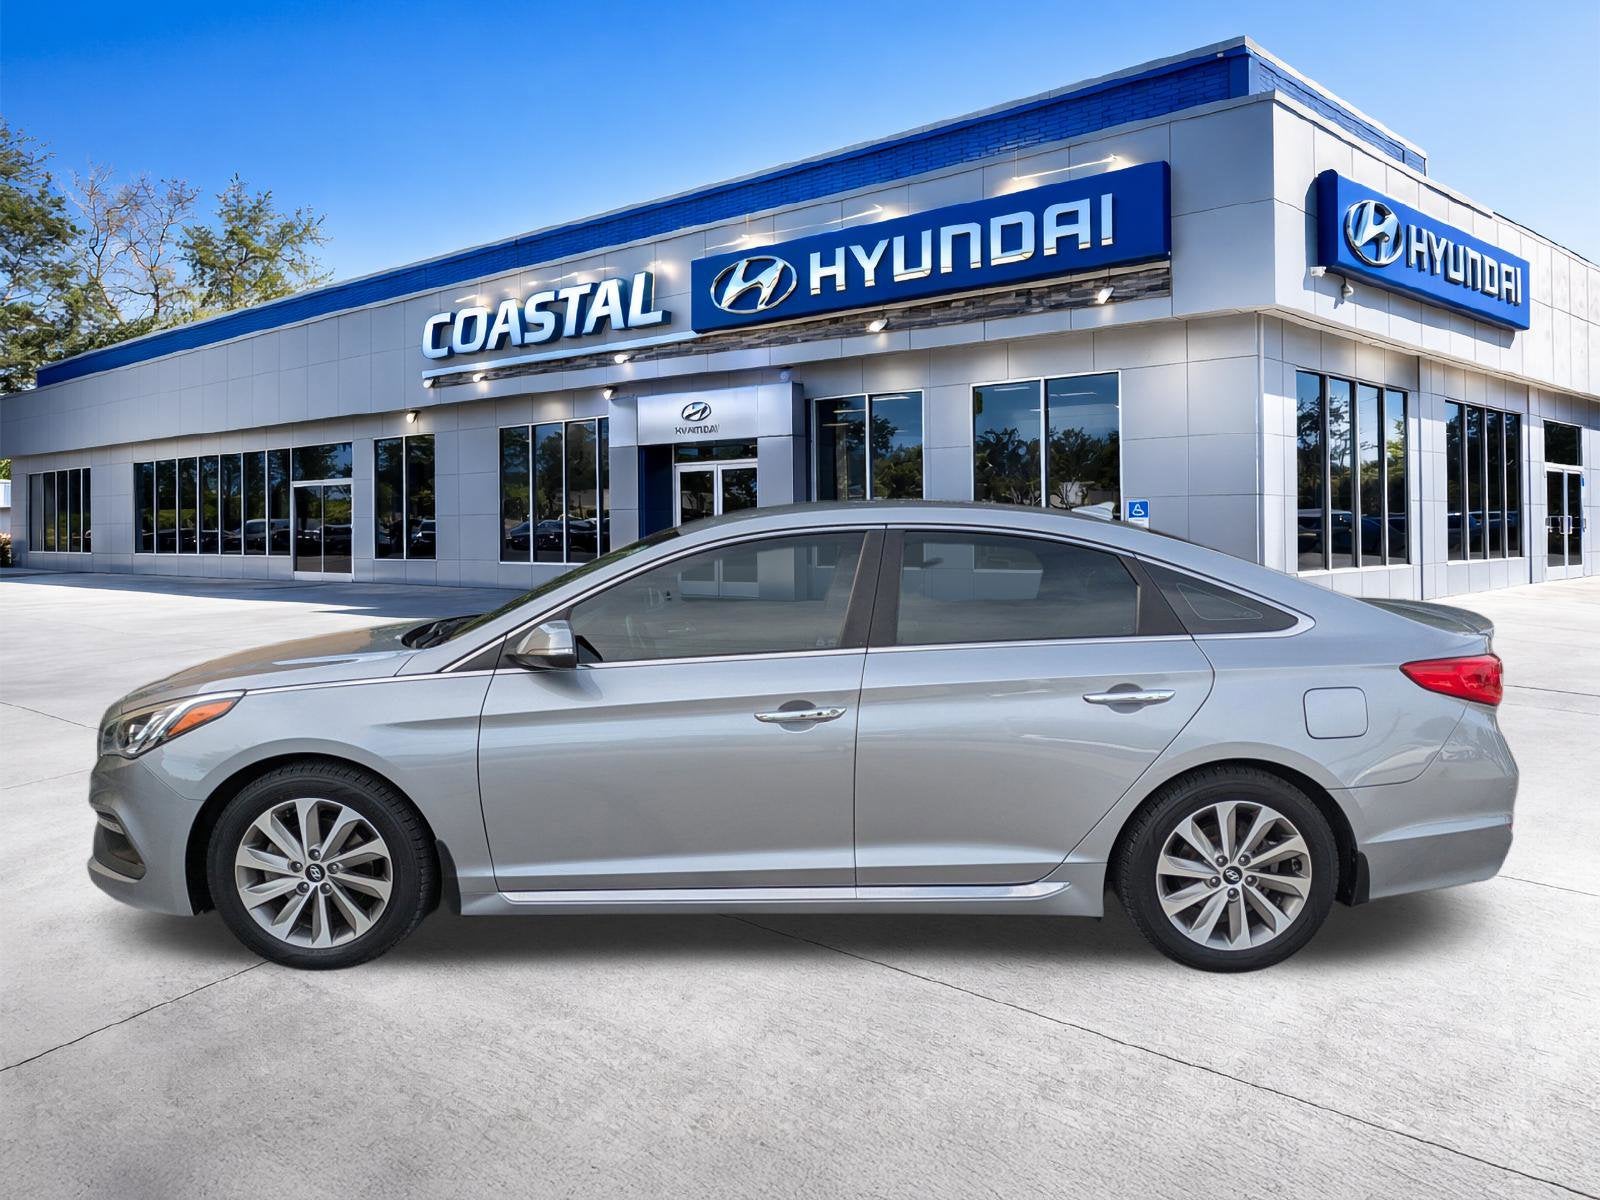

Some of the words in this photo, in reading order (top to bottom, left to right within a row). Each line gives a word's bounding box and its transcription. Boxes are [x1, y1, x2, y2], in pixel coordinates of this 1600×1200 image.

[809, 192, 1114, 296] HYUNDAI
[1406, 224, 1522, 306] HYUNDAI
[422, 271, 670, 359] COASTAL
